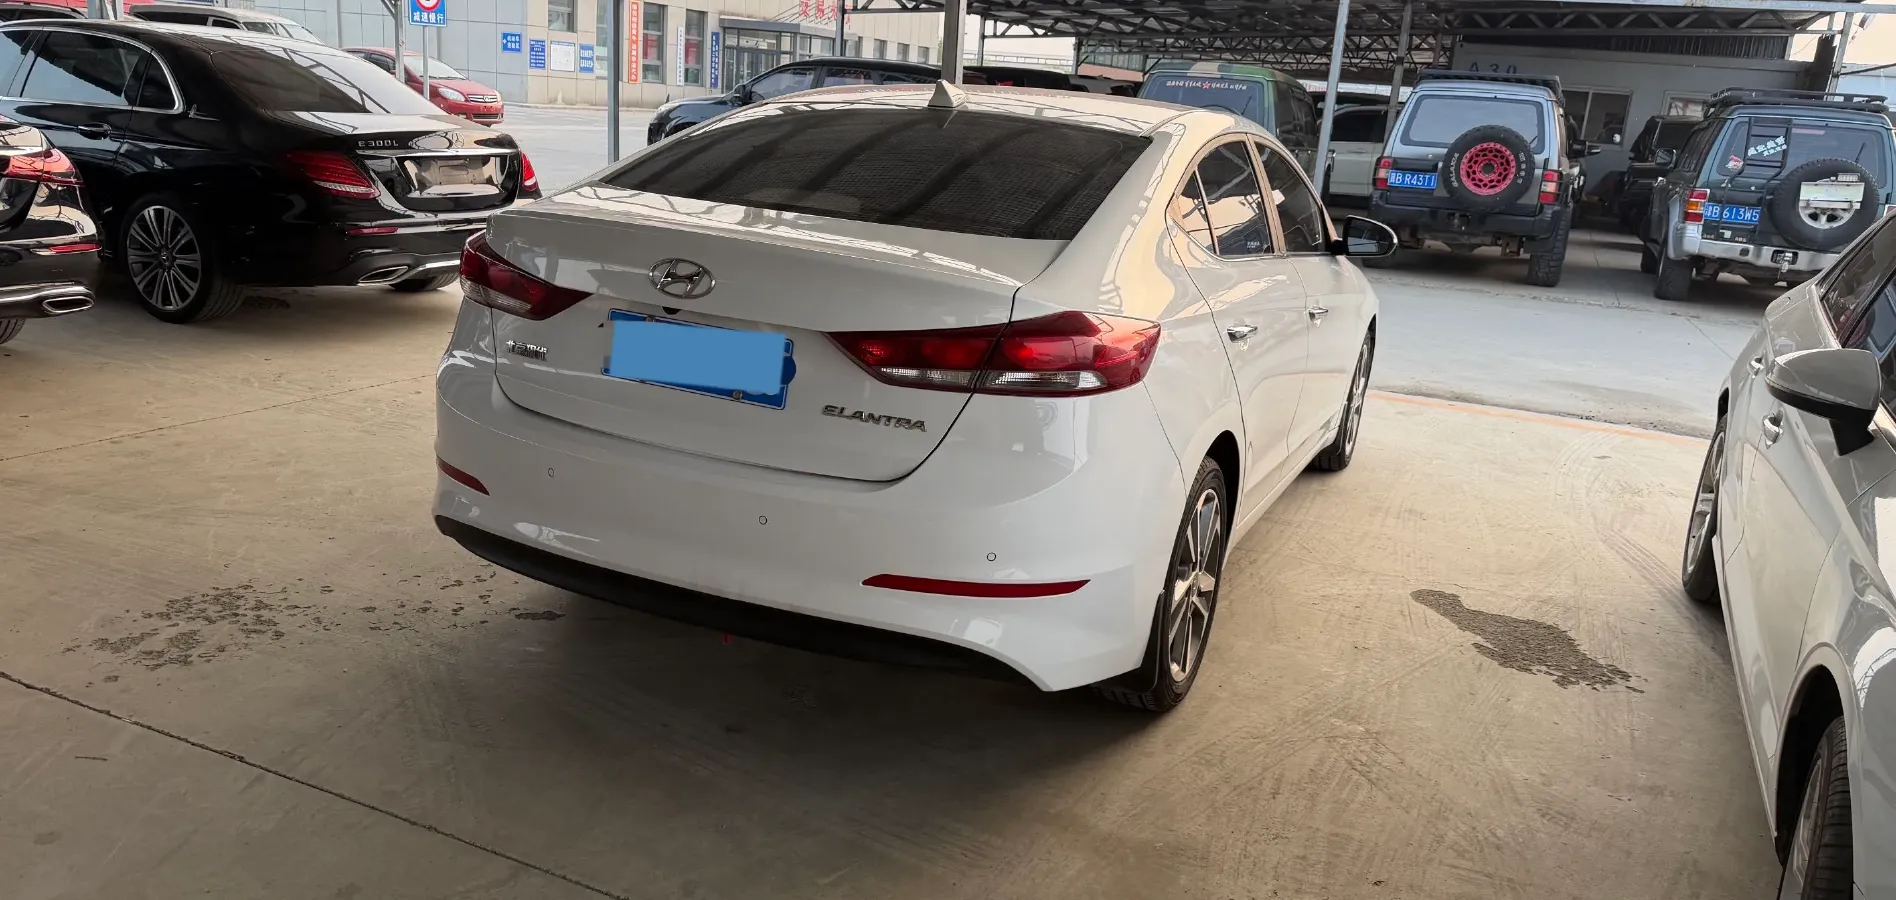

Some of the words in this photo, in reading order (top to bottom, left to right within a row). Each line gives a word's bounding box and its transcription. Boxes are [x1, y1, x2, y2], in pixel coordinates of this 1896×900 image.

[413, 11, 444, 24] 减速慢行
[821, 404, 928, 433] ELANTRA
